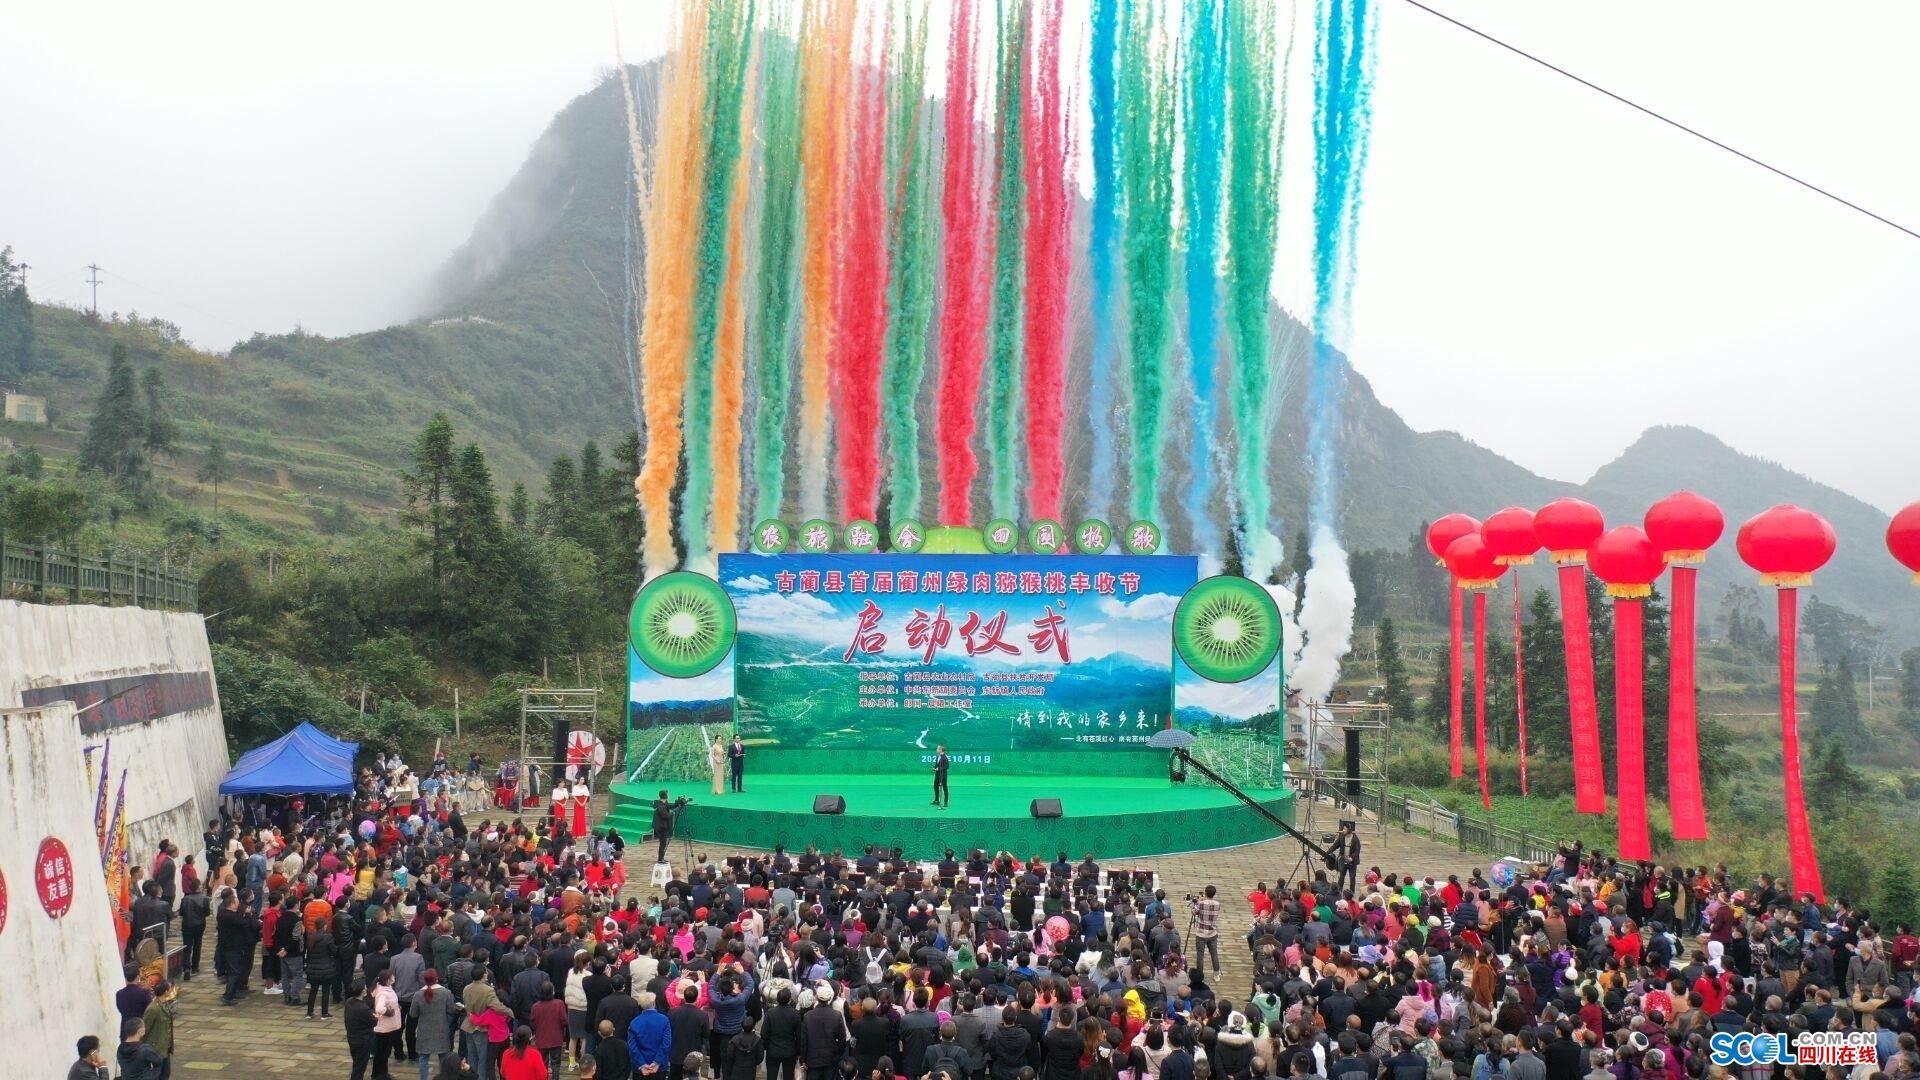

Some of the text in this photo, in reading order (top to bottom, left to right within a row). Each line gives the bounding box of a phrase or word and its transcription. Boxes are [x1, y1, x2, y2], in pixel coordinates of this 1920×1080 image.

[775, 570, 1141, 594] 古蔺县首届蔺州绿肉猕猴桃丰收节
[843, 599, 1073, 665] 启动仪式
[921, 755, 991, 764] 20210月11日
[43, 856, 66, 880] 诚信
[47, 877, 69, 901] 友善
